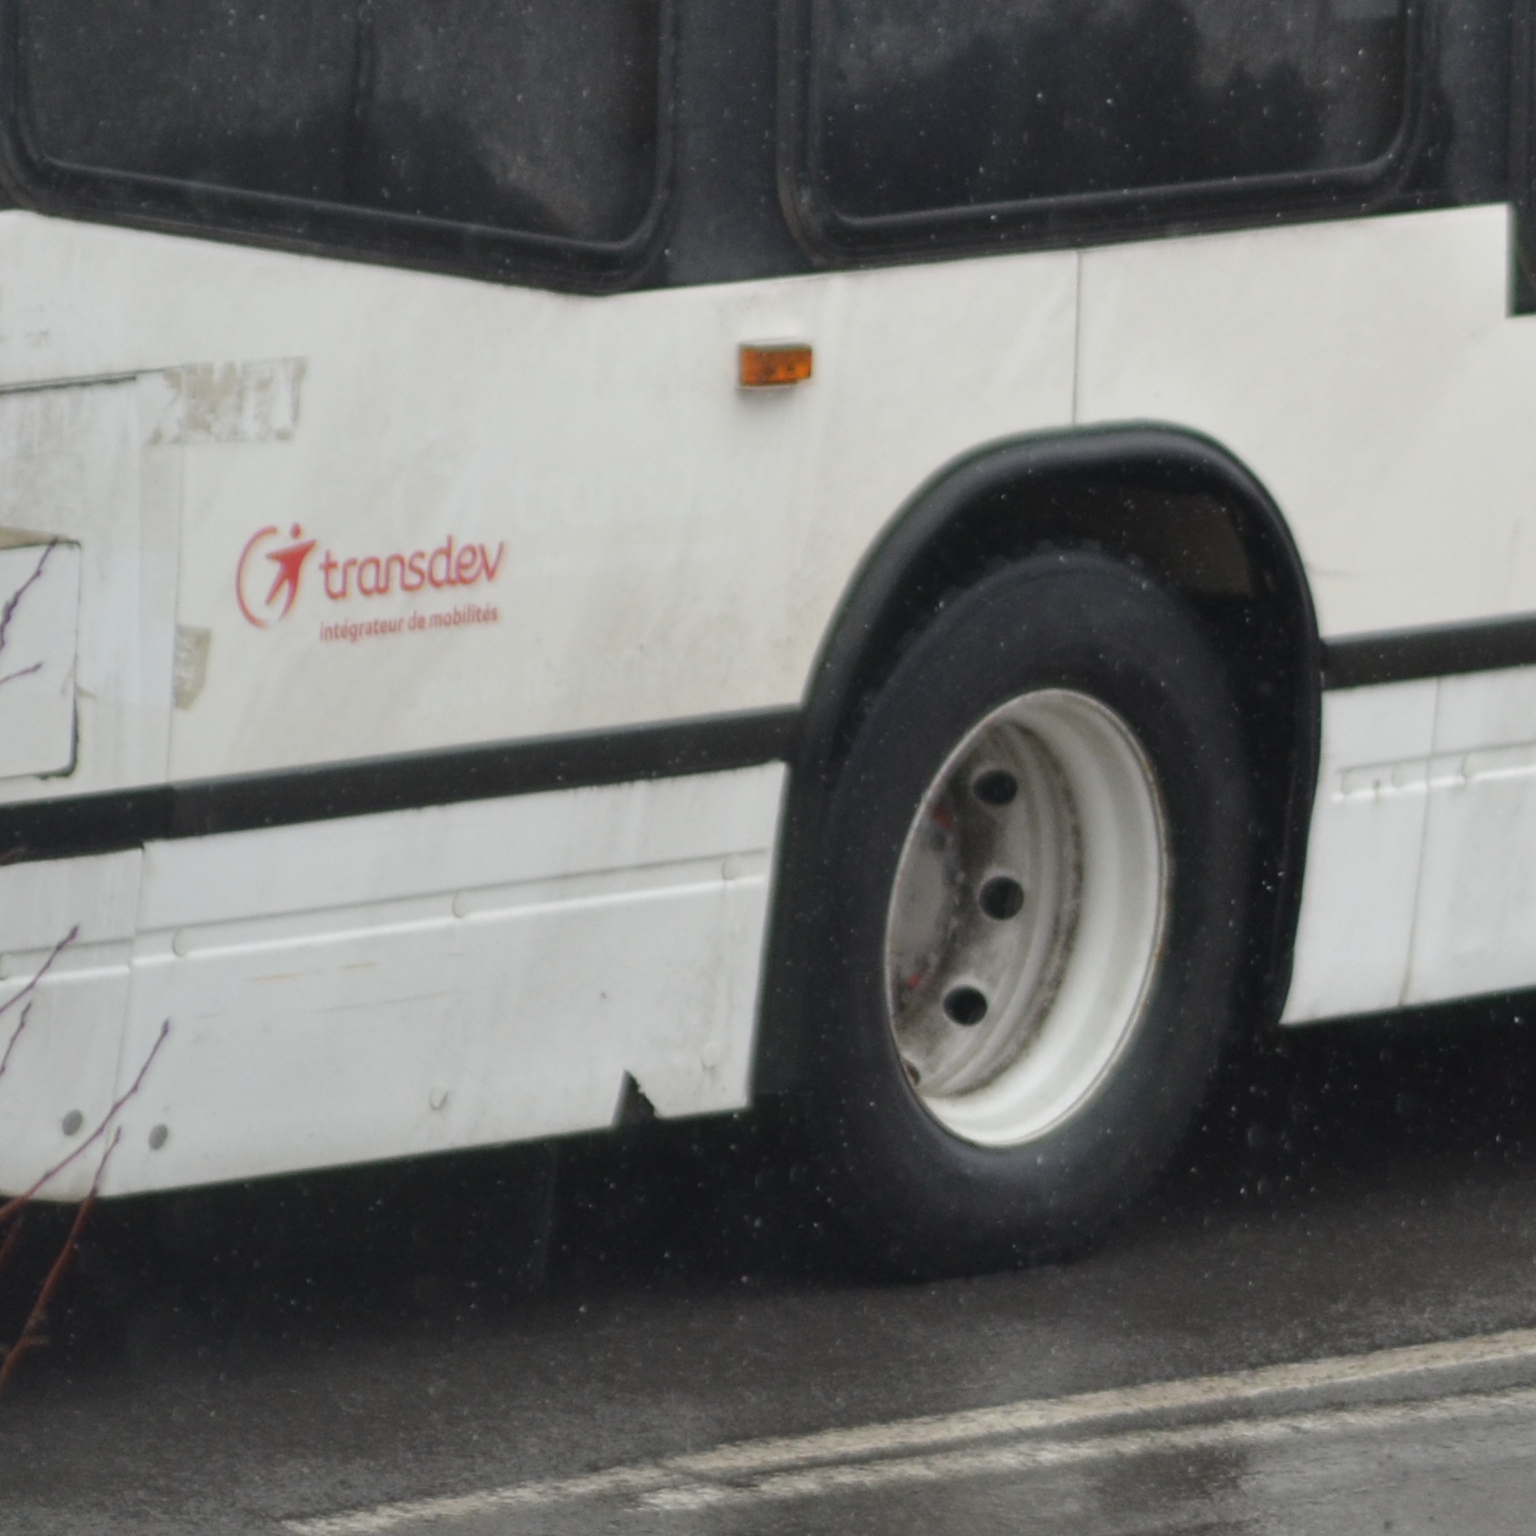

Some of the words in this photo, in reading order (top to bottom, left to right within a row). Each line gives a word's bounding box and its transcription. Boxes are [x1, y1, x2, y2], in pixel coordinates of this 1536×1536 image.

[318, 535, 506, 600] transdev
[319, 616, 404, 642] intégrateur
[407, 609, 426, 630] de
[429, 603, 499, 629] mobilités
